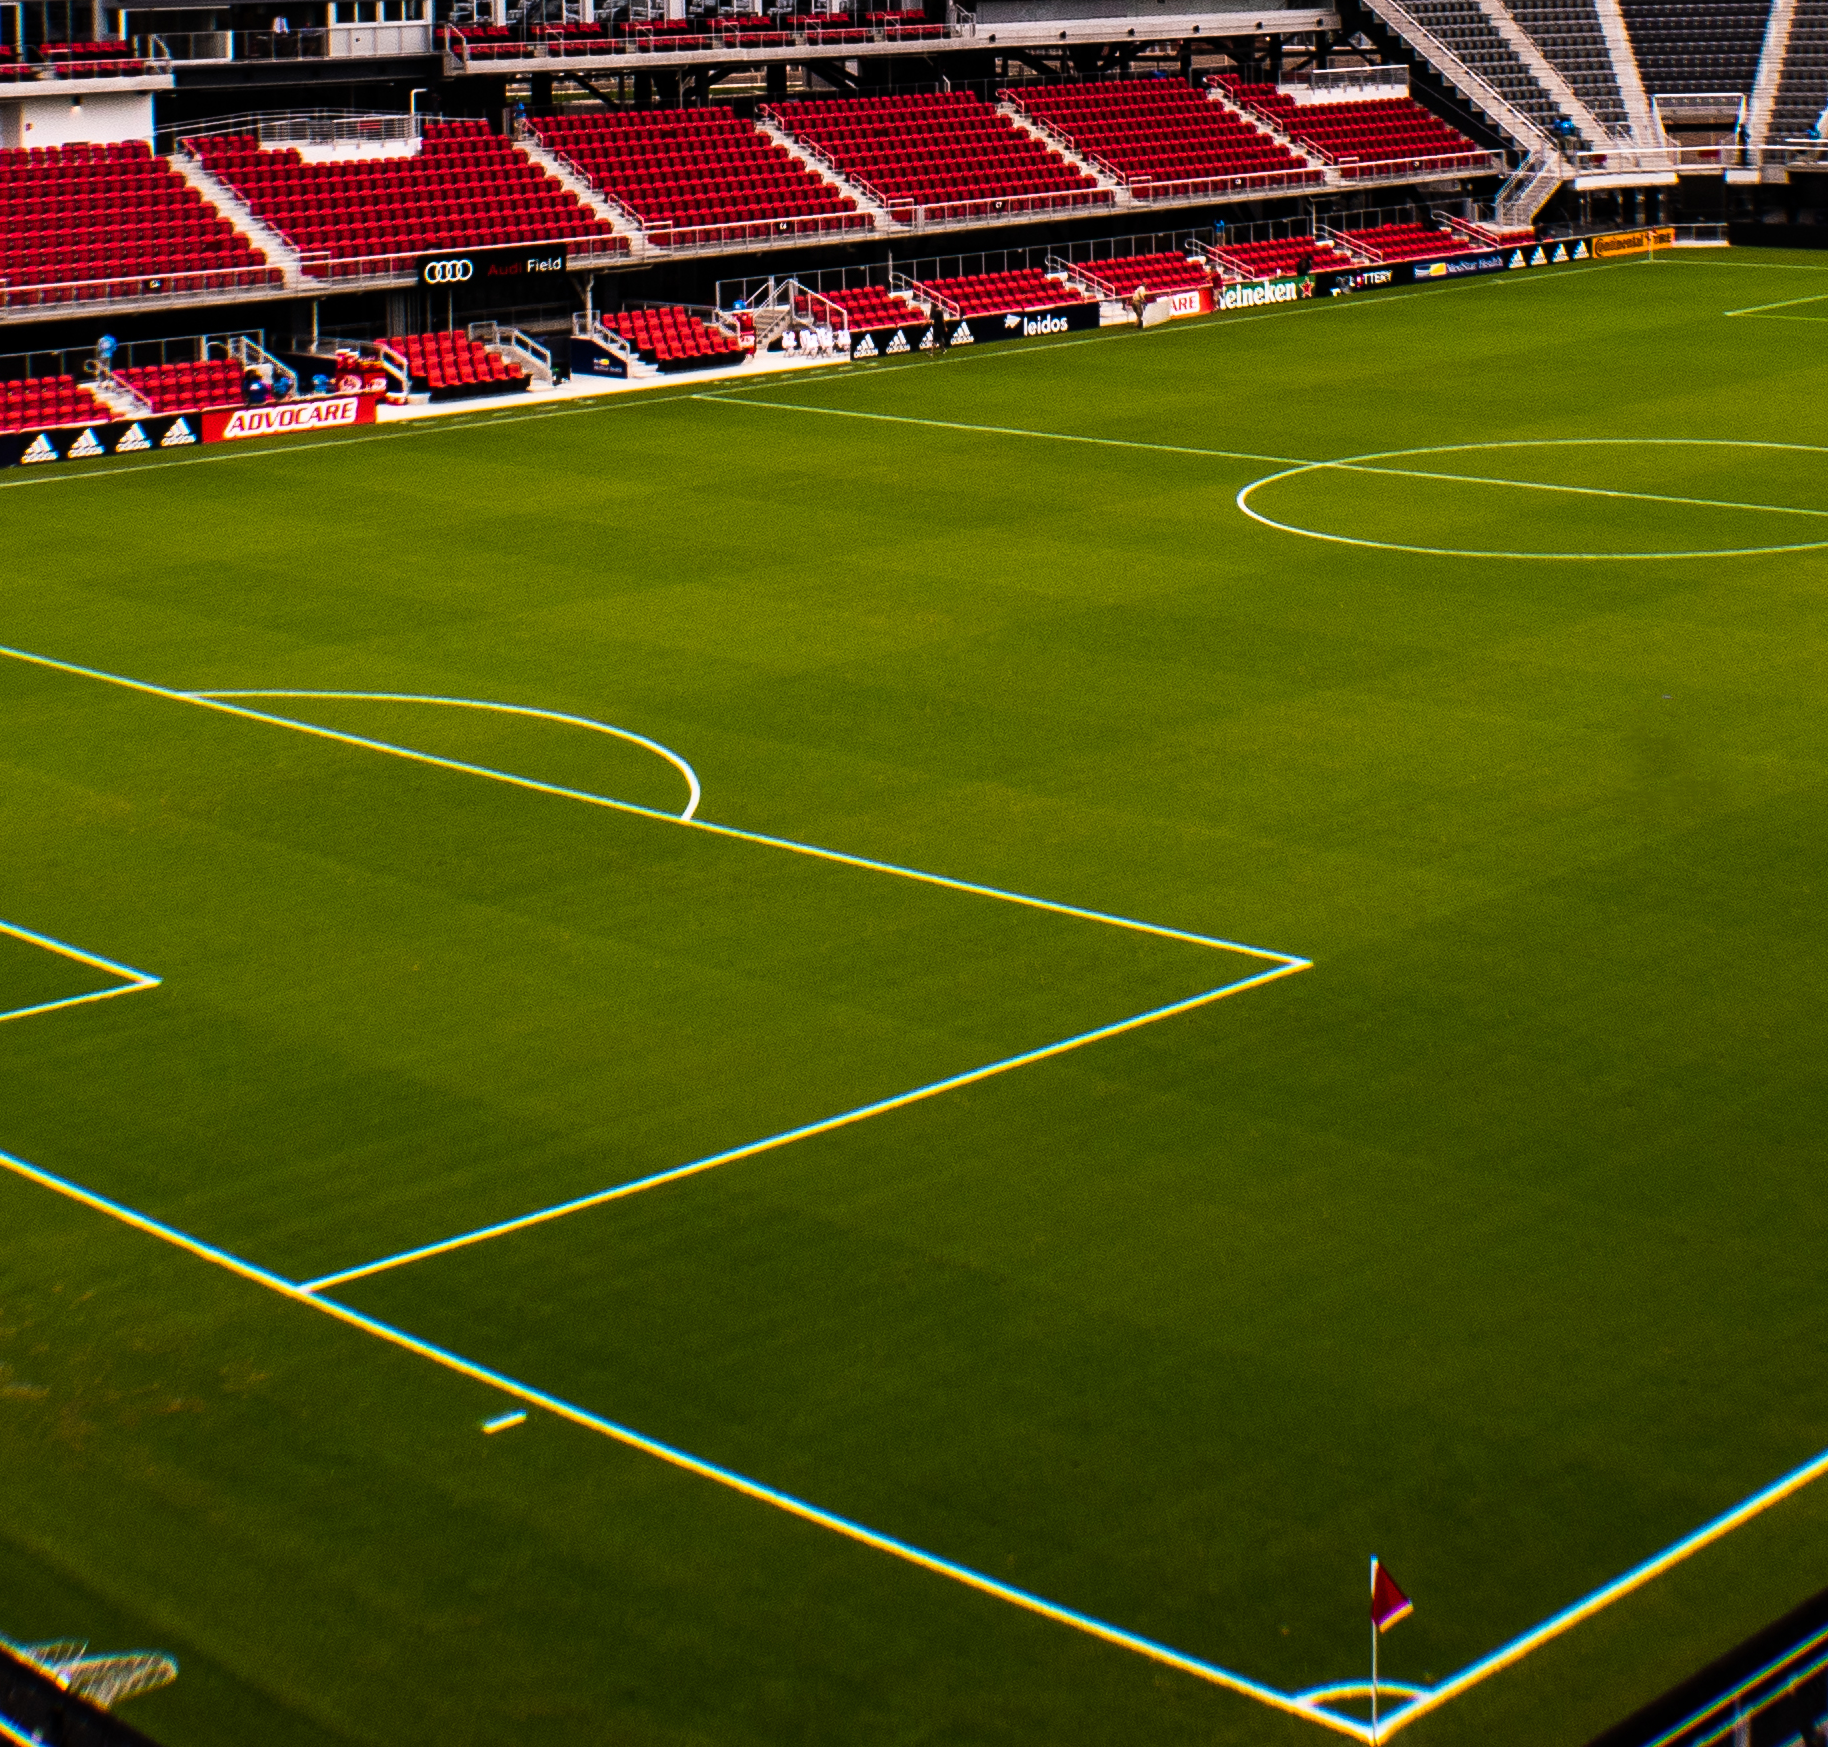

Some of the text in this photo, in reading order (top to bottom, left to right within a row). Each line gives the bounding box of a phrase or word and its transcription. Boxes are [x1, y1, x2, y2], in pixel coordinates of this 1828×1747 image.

[487, 256, 562, 277] Audi Field
[1023, 314, 1068, 336] leidos
[227, 400, 355, 433] ADVOCARE
